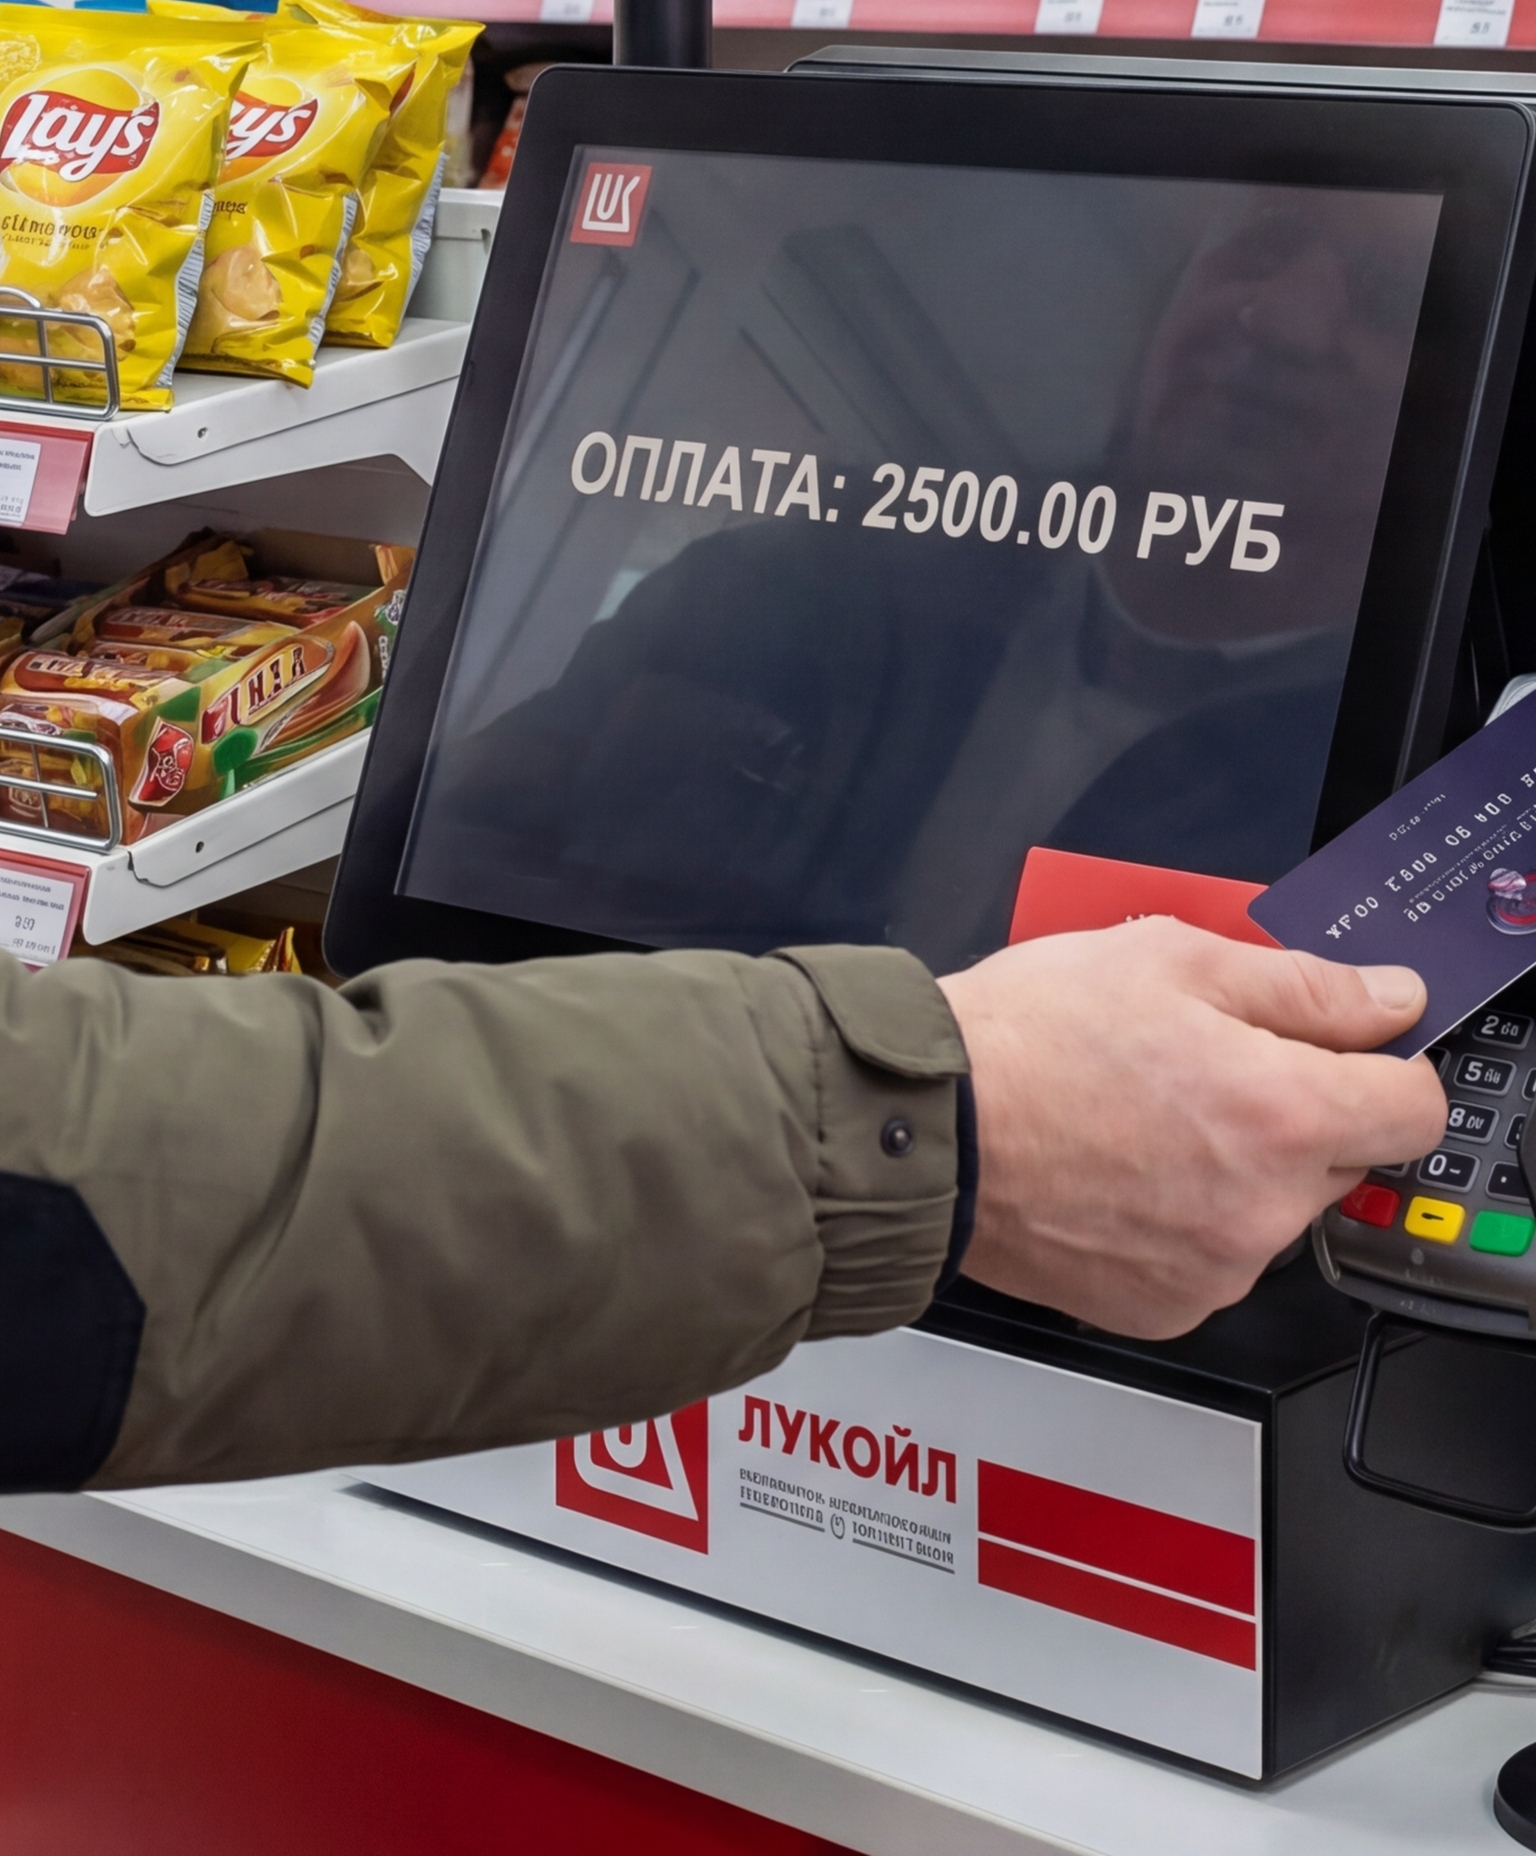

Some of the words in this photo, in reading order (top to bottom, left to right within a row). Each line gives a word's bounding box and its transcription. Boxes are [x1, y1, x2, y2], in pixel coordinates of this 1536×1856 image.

[571, 431, 845, 523] ОПЛАТА:
[863, 462, 1117, 555] 2500.00
[1136, 491, 1285, 573] РУБ
[1480, 1015, 1499, 1036] 2
[1464, 1061, 1483, 1082] 5
[1448, 1107, 1466, 1128] 8
[737, 1394, 957, 1505] ЛУКОЙЛ
